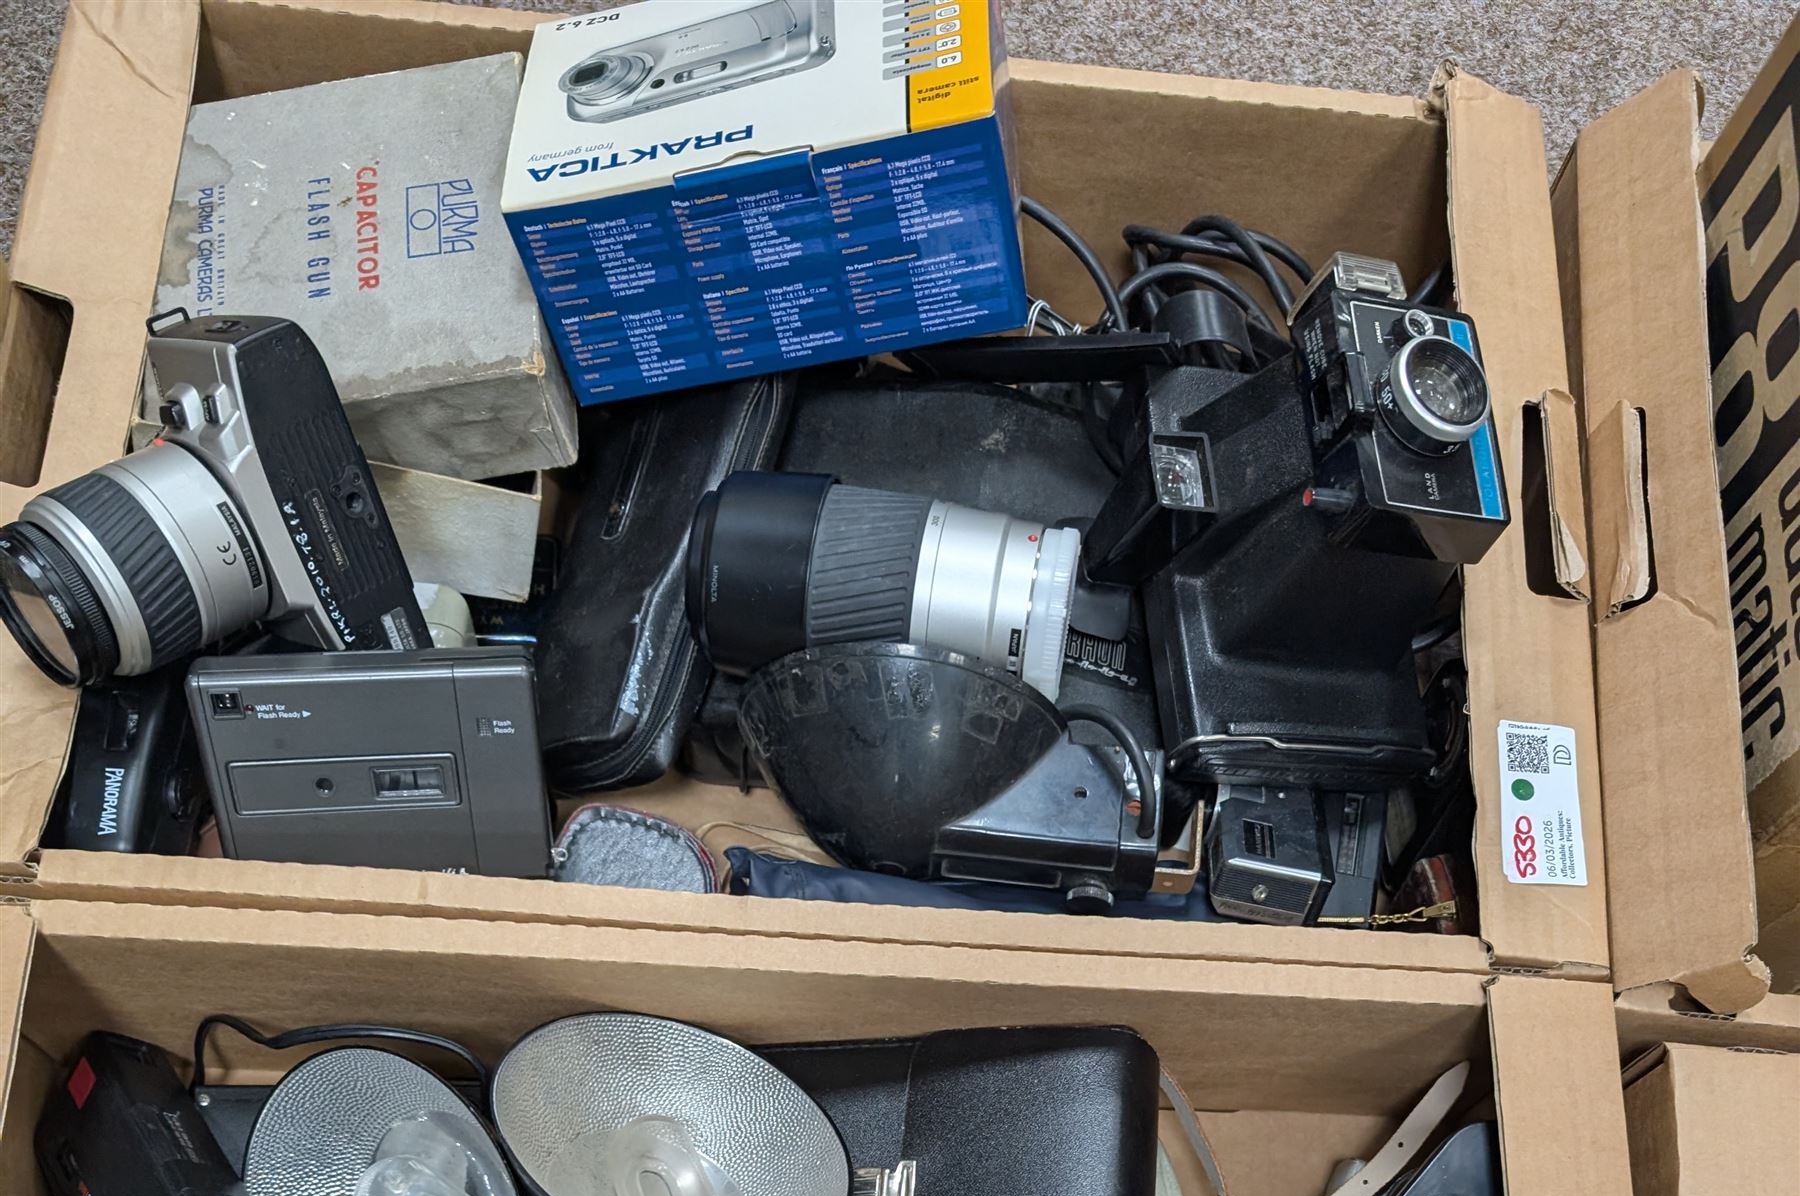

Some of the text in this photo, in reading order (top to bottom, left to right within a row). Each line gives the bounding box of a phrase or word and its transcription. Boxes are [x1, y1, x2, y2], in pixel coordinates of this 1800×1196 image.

[554, 12, 621, 32] DCZ 6.2
[941, 55, 957, 65] 6.0
[916, 75, 980, 95] still camera
[917, 90, 952, 104] digital
[526, 124, 754, 183] PRAKTICA
[527, 142, 614, 164] from germany
[355, 166, 380, 292] CAPACITOR
[440, 178, 480, 255] PURMA
[197, 187, 214, 303] PURMA CAMERAS
[307, 176, 331, 299] FLASH GUN
[1374, 321, 1384, 344] DARKEN
[1424, 472, 1435, 500] LAND
[220, 504, 242, 537] MALAYSIA
[312, 497, 330, 533] Malaysia
[330, 543, 346, 567] Made
[710, 565, 720, 603] MINOLTA
[48, 593, 75, 631] JESSOP
[255, 703, 286, 712] WAIT for
[257, 709, 301, 719] Flash Ready
[492, 719, 512, 727] Flash
[493, 727, 516, 735] Ready
[97, 767, 125, 836] PANORAMA
[1556, 810, 1569, 879] Affordable Antiques:
[1565, 818, 1574, 844] Picture
[1543, 820, 1558, 878] 06/03/2026
